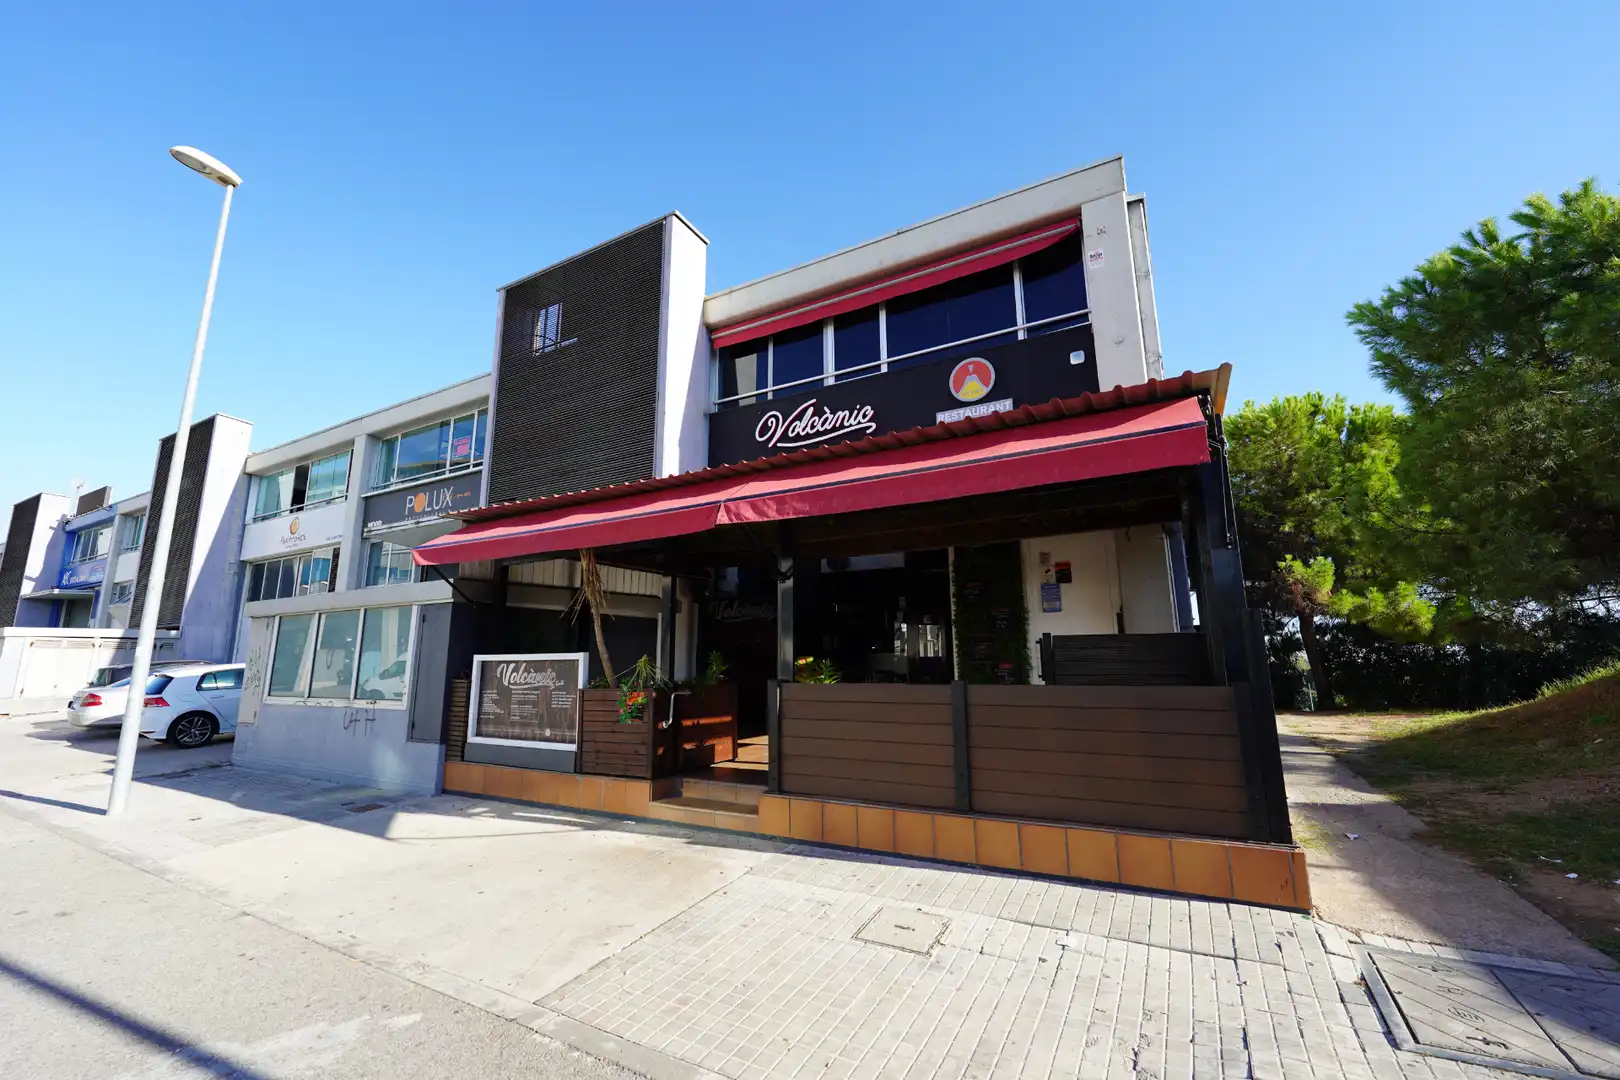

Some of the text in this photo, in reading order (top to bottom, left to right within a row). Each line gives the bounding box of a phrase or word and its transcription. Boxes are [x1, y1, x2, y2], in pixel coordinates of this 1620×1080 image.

[755, 398, 877, 448] Volcànic
[937, 400, 1012, 422] RESTAURANT
[405, 486, 453, 516] POLUX
